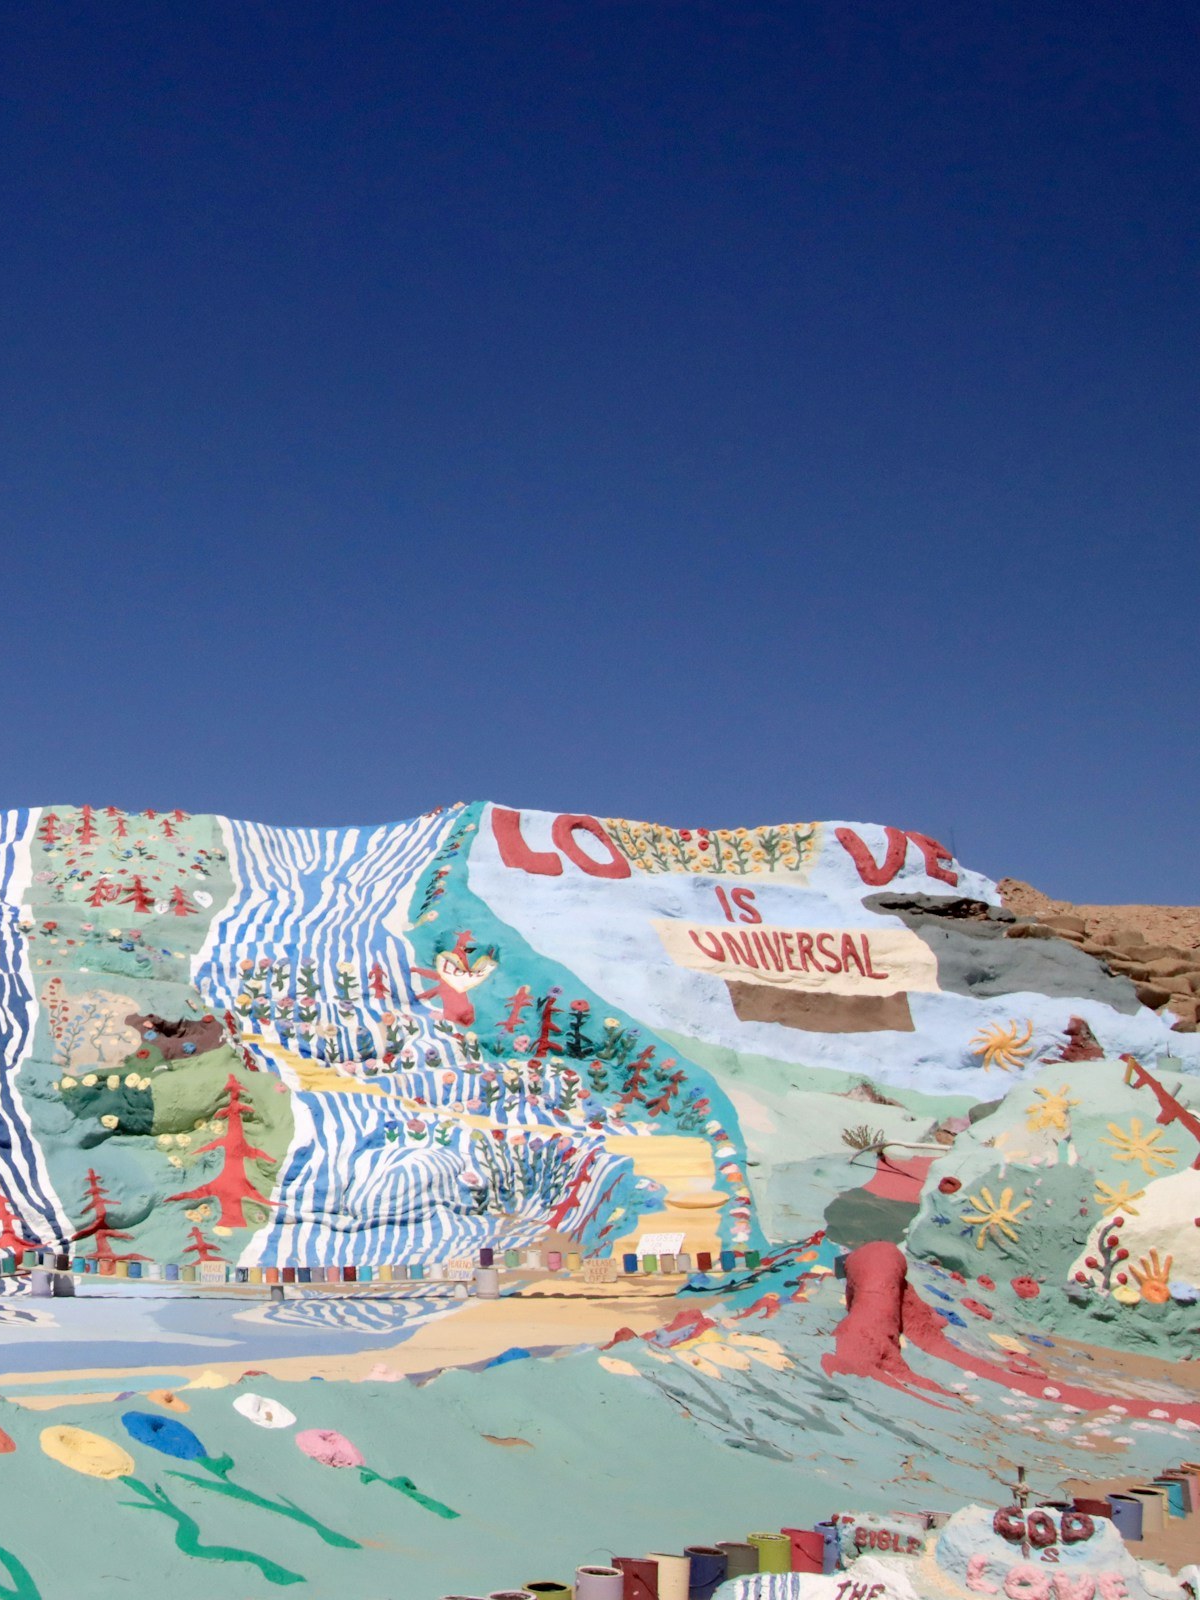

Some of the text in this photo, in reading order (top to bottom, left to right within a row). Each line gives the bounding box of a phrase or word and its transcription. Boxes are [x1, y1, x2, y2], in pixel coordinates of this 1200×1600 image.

[714, 885, 762, 924] IS
[689, 929, 890, 979] UNIVERSAL
[853, 1526, 923, 1557] BIBLE
[992, 1505, 1096, 1549] GOD
[1022, 1542, 1061, 1564] IS
[964, 1554, 1130, 1600] LOVE
